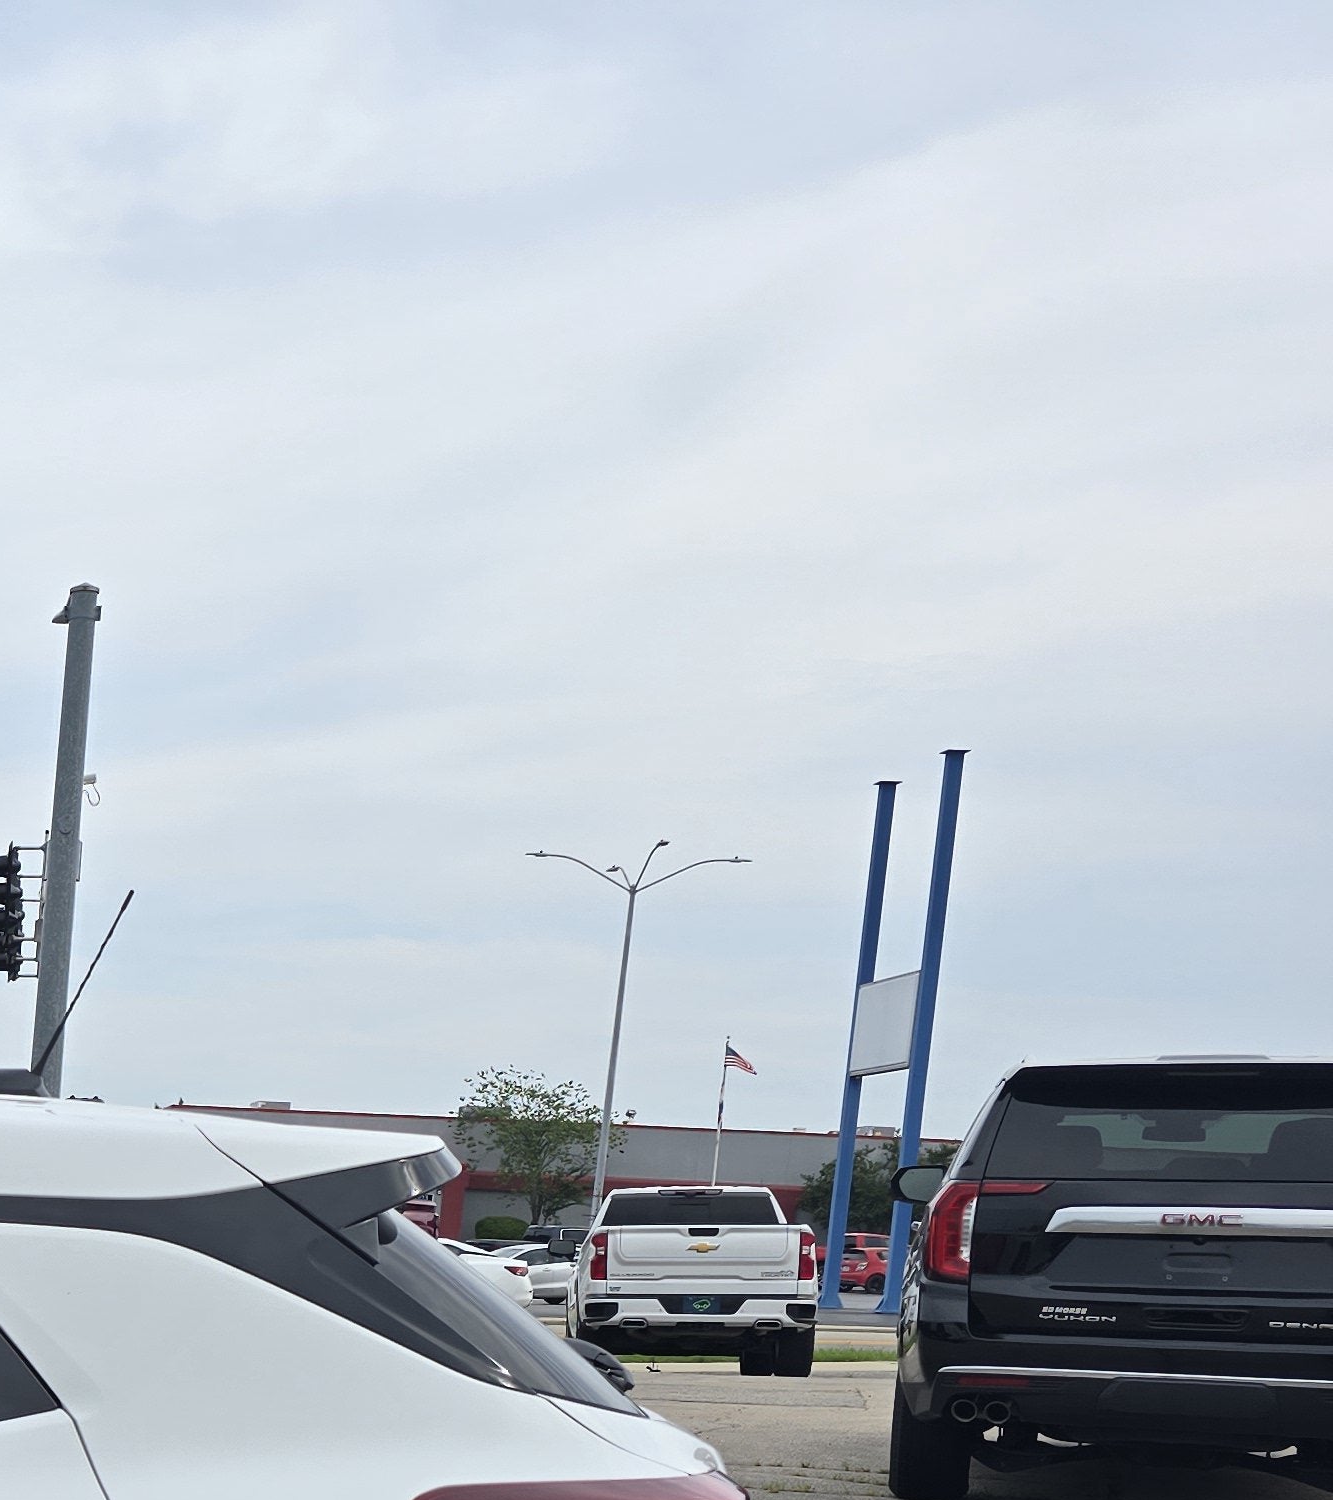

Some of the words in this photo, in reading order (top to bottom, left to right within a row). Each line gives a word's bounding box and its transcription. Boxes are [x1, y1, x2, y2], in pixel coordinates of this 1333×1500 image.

[1160, 1213, 1243, 1227] GMC
[1055, 1306, 1088, 1315] MORSE
[1038, 1313, 1117, 1322] YUKON
